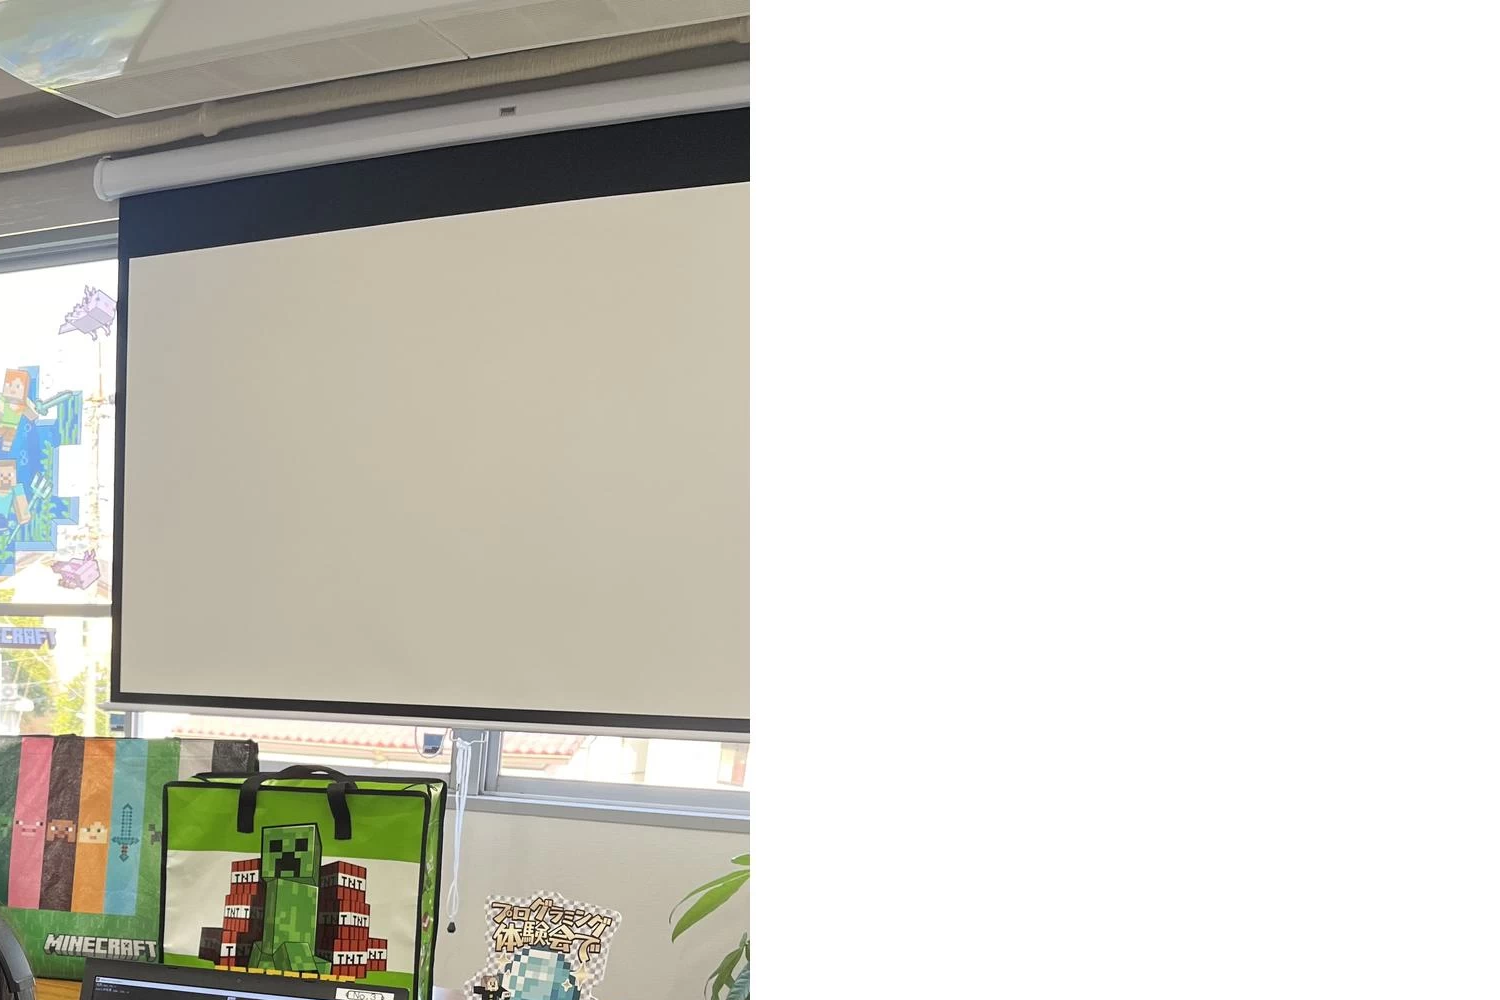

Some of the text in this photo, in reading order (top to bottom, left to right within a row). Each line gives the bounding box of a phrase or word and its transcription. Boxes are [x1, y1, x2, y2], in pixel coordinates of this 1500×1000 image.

[234, 872, 256, 883] TNT
[341, 875, 363, 886] TNT
[352, 914, 368, 926] TNT
[491, 897, 612, 937] プログラミング
[492, 920, 602, 963] 体験会で
[43, 934, 157, 961] MINECRAFT
[336, 953, 364, 964] TNT
[353, 991, 377, 1000] No.3
